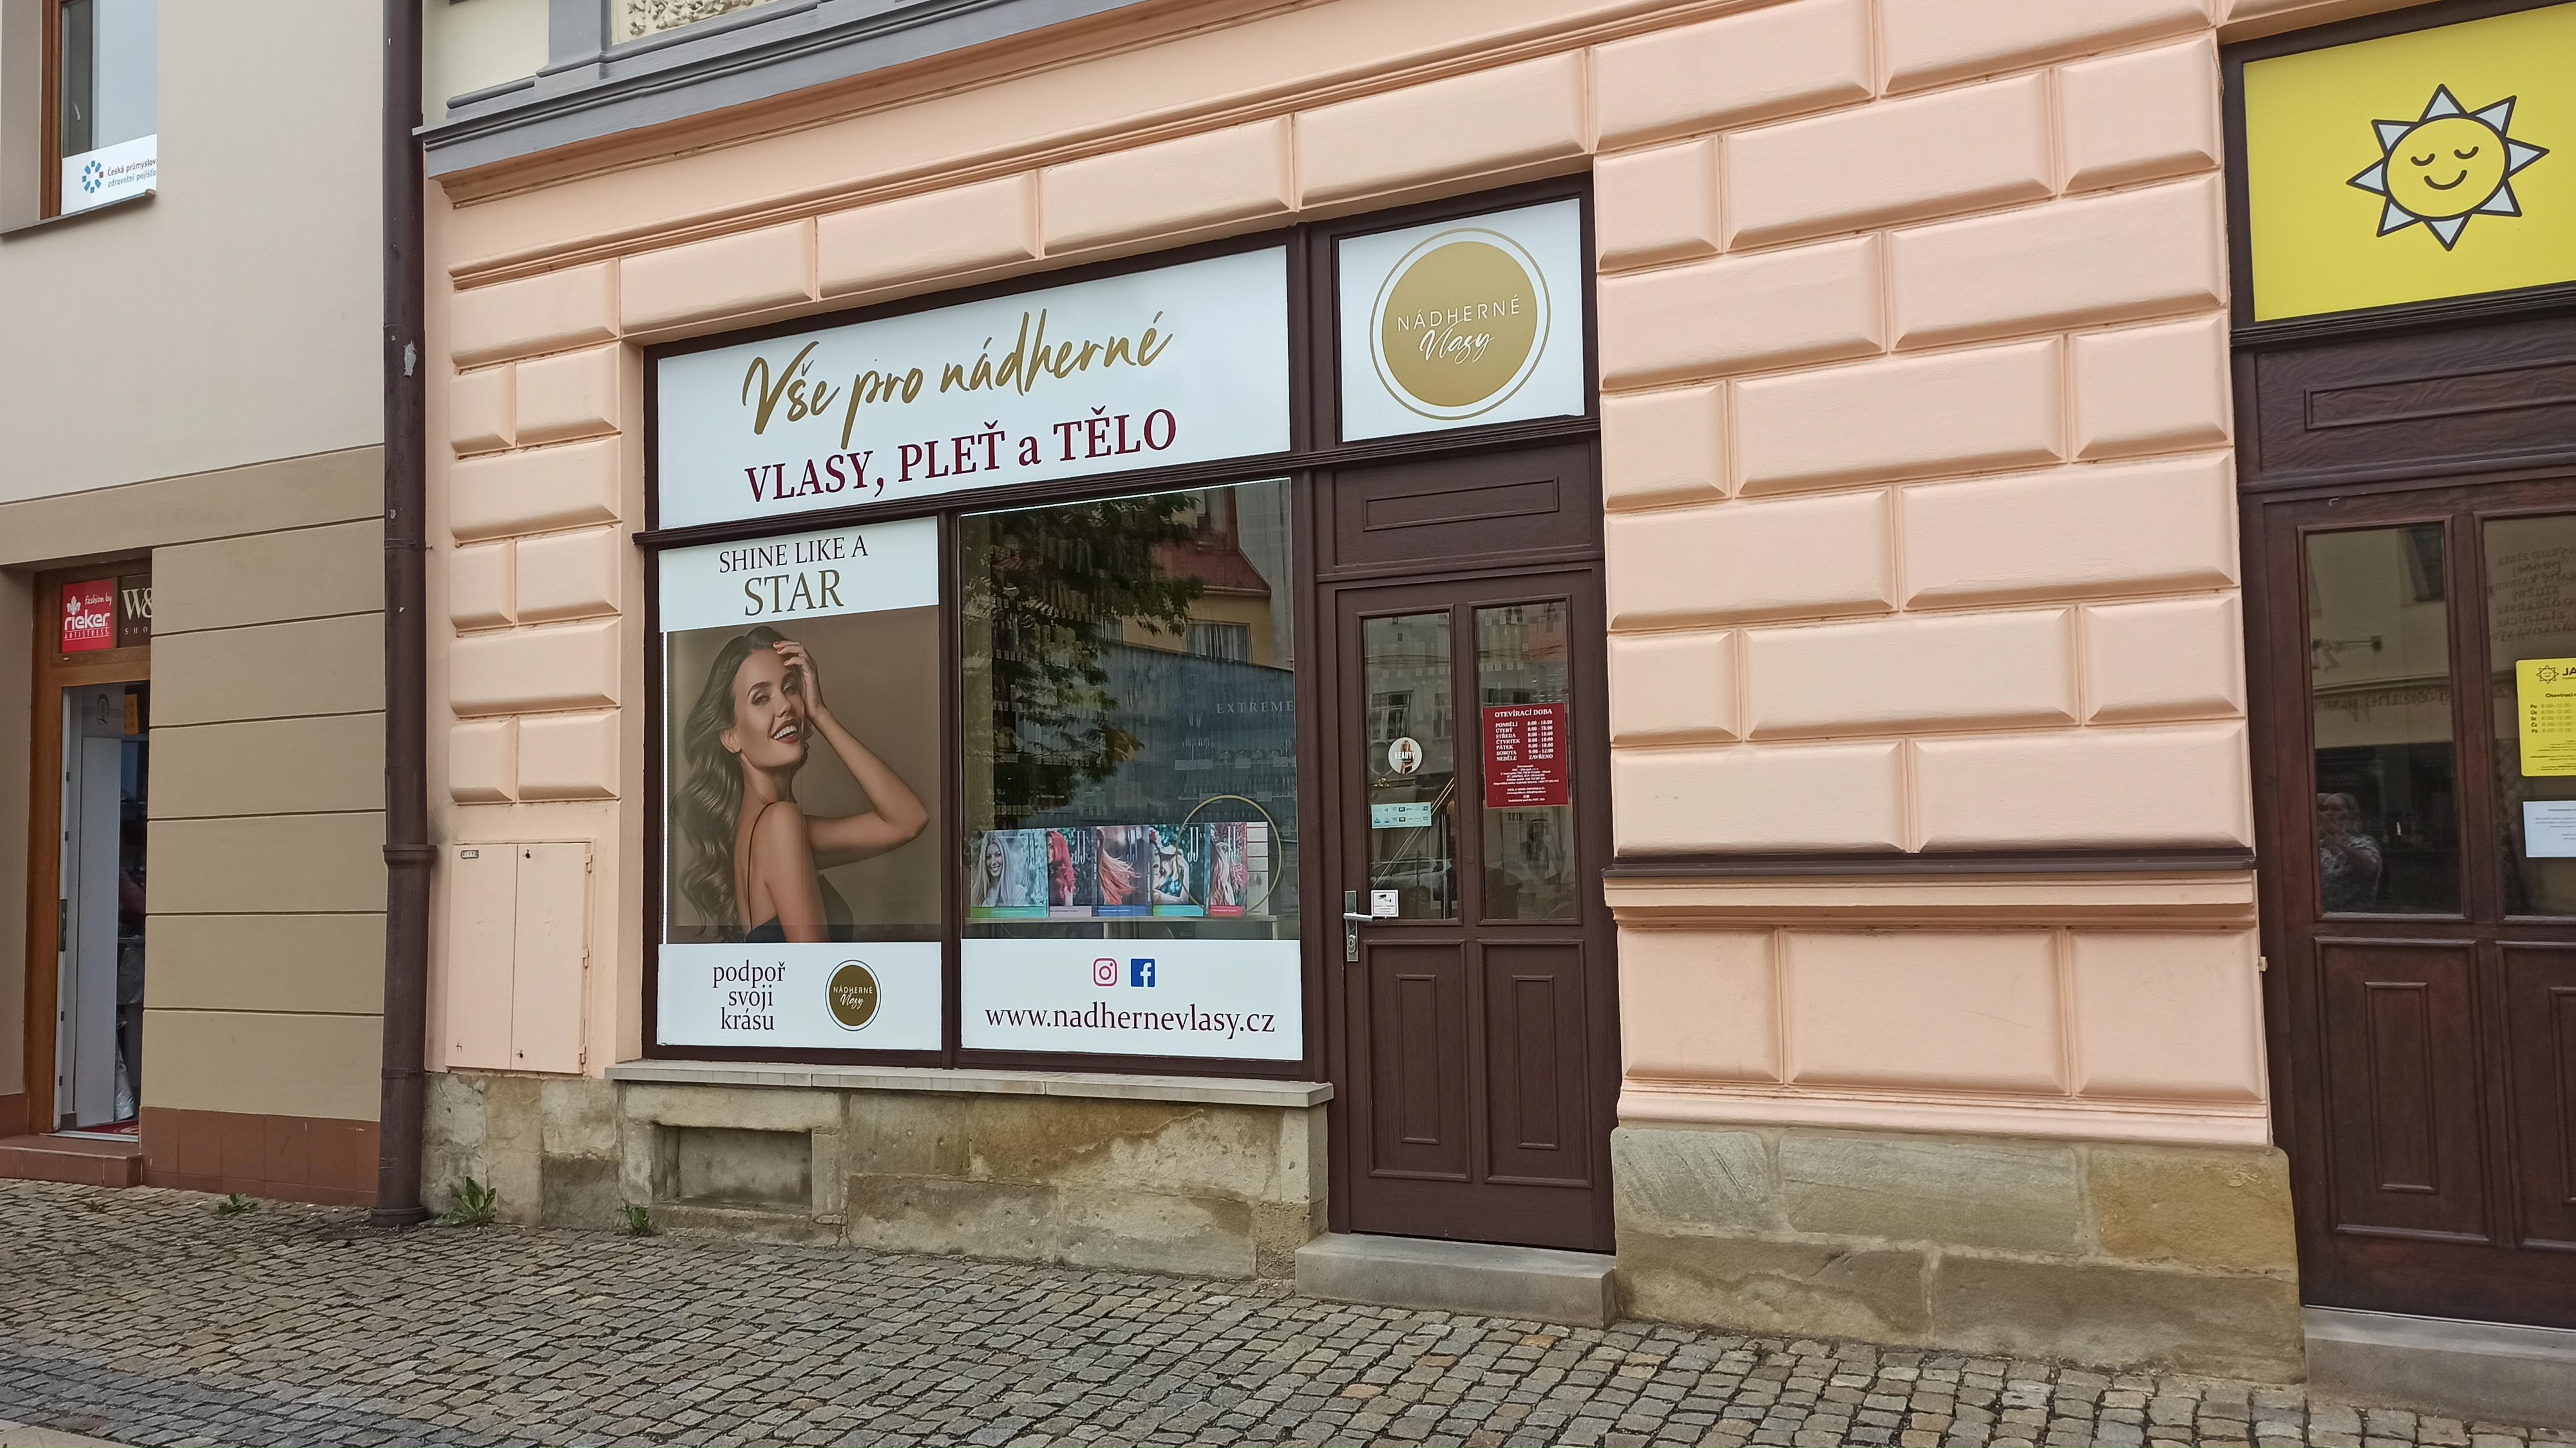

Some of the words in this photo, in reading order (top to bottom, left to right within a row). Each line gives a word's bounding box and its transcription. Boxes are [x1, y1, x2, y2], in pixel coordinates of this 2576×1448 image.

[107, 165, 124, 176] Česká
[126, 158, 157, 173] průmyslov
[108, 173, 135, 187] zdravotní
[137, 169, 156, 183] pojišťo
[1396, 294, 1520, 332] NÁDHERNÉ
[742, 341, 840, 435] Vše
[840, 366, 923, 449] pro
[940, 308, 1173, 396] nádherné
[744, 450, 886, 503] VLASY,
[898, 420, 1007, 484] PLEŤ
[1018, 436, 1041, 466] a
[1053, 405, 1177, 462] TĚLO
[719, 544, 788, 573] SHINE
[795, 536, 846, 565] LIKE
[851, 534, 869, 558] A
[105, 592, 112, 606] by
[744, 569, 844, 617] STAR
[64, 609, 110, 630] rieker
[1217, 700, 1294, 714] EXTREME
[1495, 708, 1531, 717] OTEVÍRACÍ
[712, 959, 786, 988] podpoř
[728, 984, 773, 1013] svoji
[833, 984, 873, 995] NÁDHERNÉ
[721, 1007, 775, 1031] krásu
[985, 1001, 1276, 1040] www.nadhernevlasy.cz
